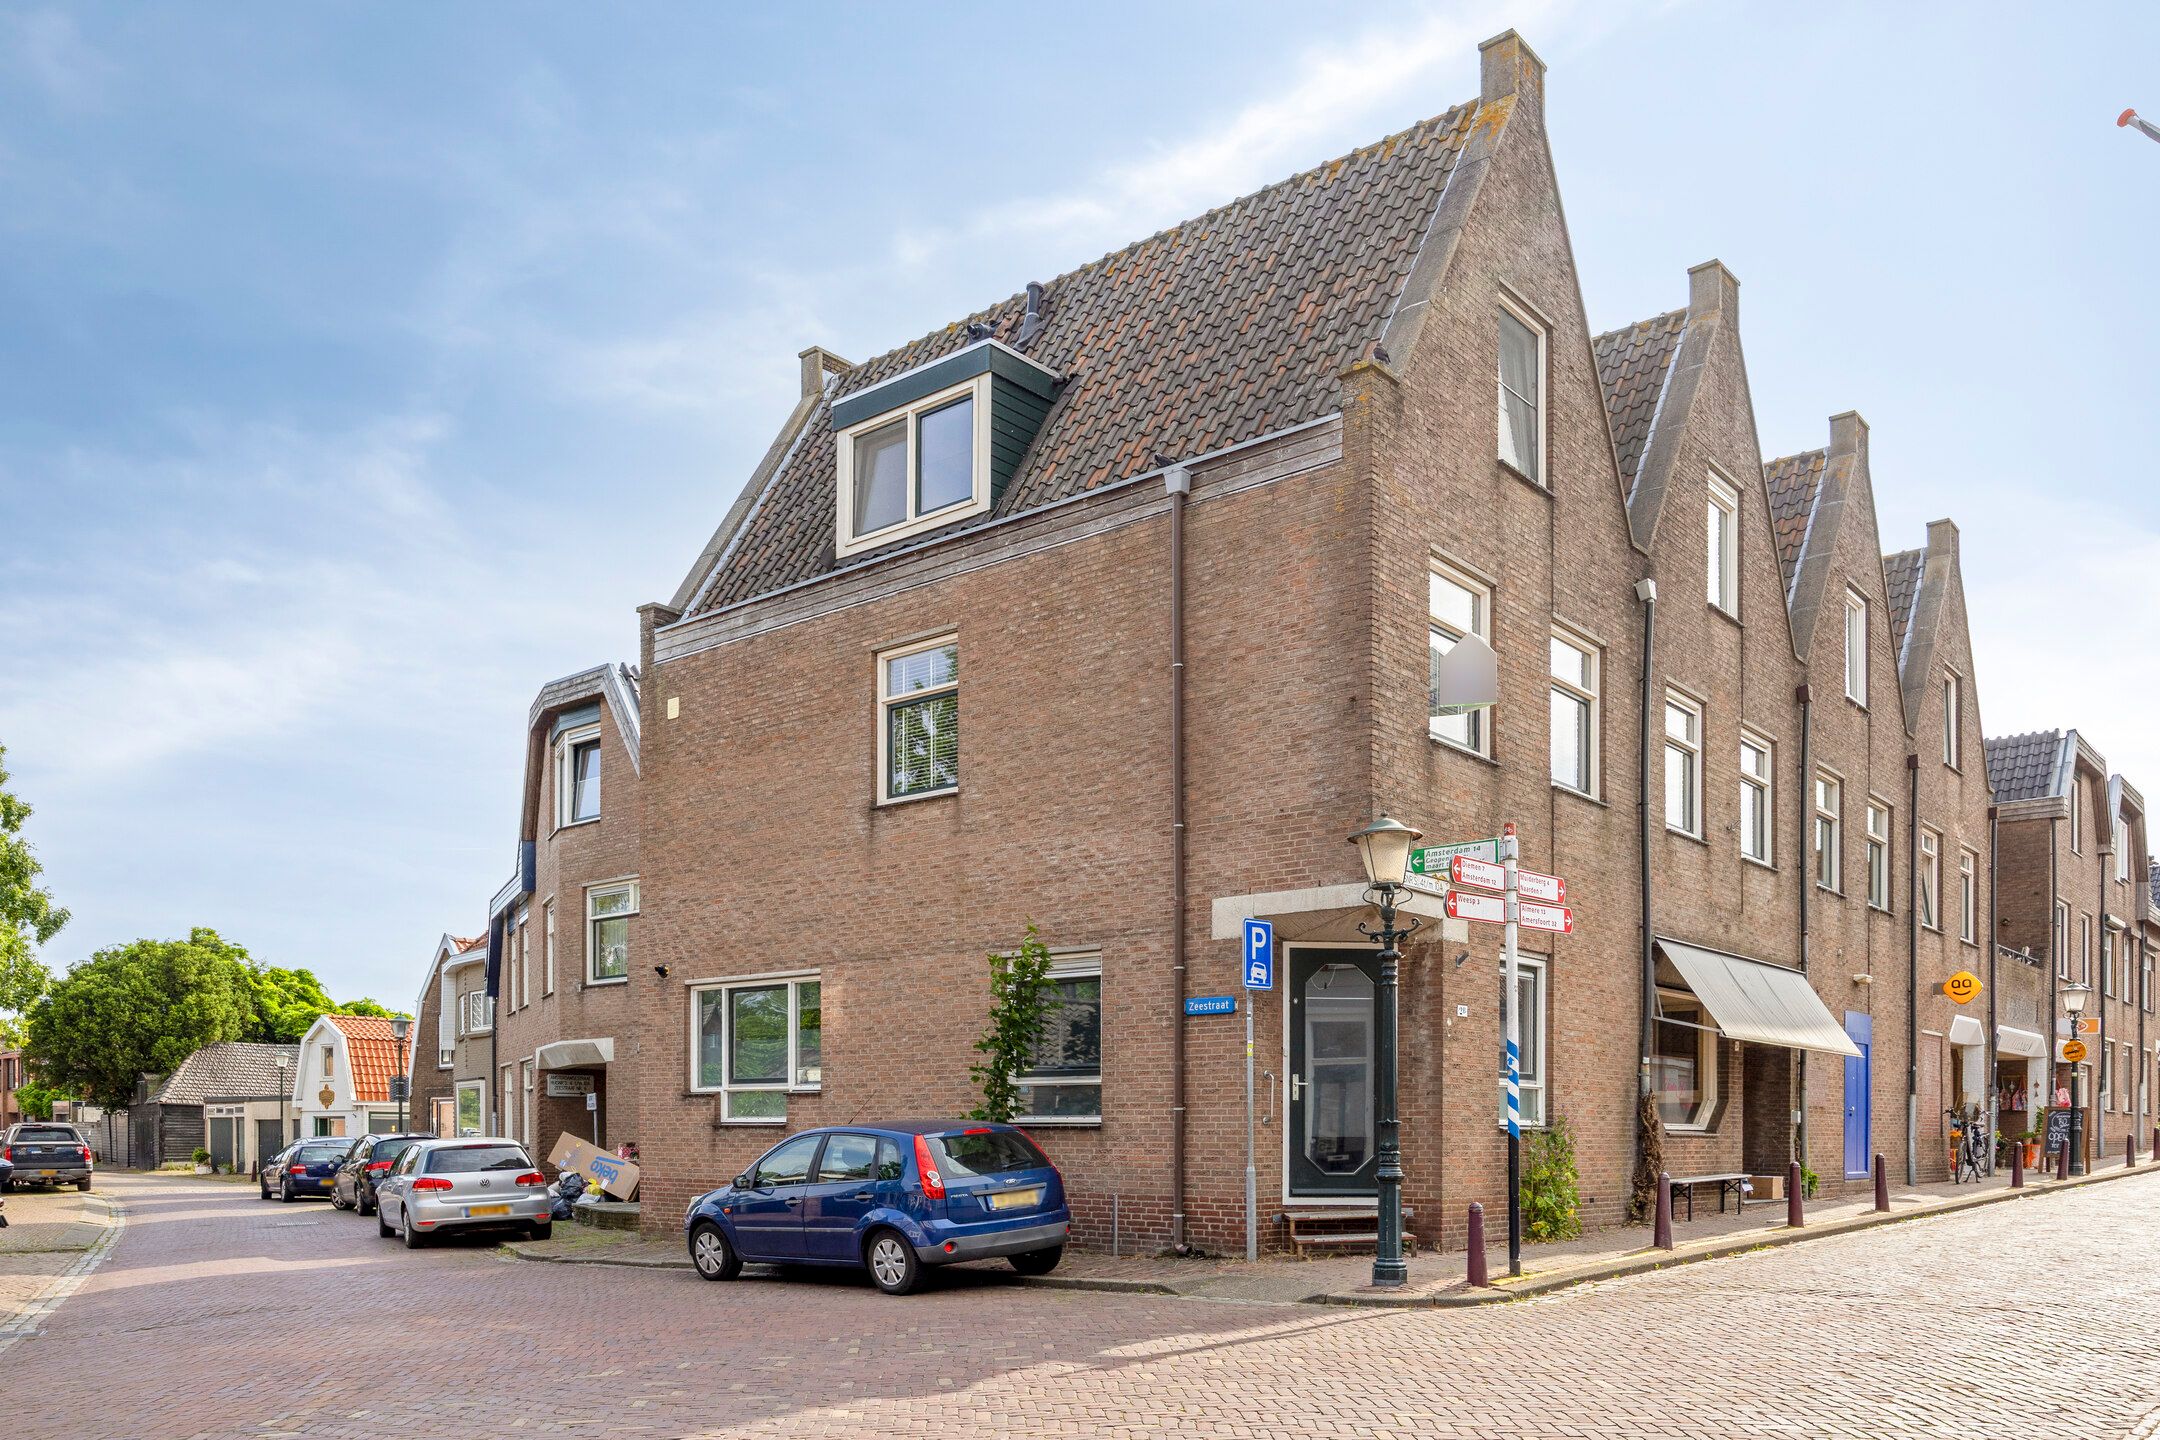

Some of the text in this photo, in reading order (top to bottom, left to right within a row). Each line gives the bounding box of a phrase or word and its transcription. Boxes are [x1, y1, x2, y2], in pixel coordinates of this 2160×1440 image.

[1425, 847, 1470, 857] Amsterdam
[1425, 856, 1452, 864] Geopen
[1462, 860, 1481, 870] Diemen
[1462, 872, 1491, 884] Amsterdam
[1520, 885, 1539, 893] Naarden
[1457, 895, 1476, 905] Weesp
[1522, 905, 1540, 913] Almere
[1522, 916, 1551, 926] Amersfoort
[1251, 926, 1267, 960] P
[1188, 1000, 1229, 1011] Zeestraat
[590, 1160, 618, 1184] beko
